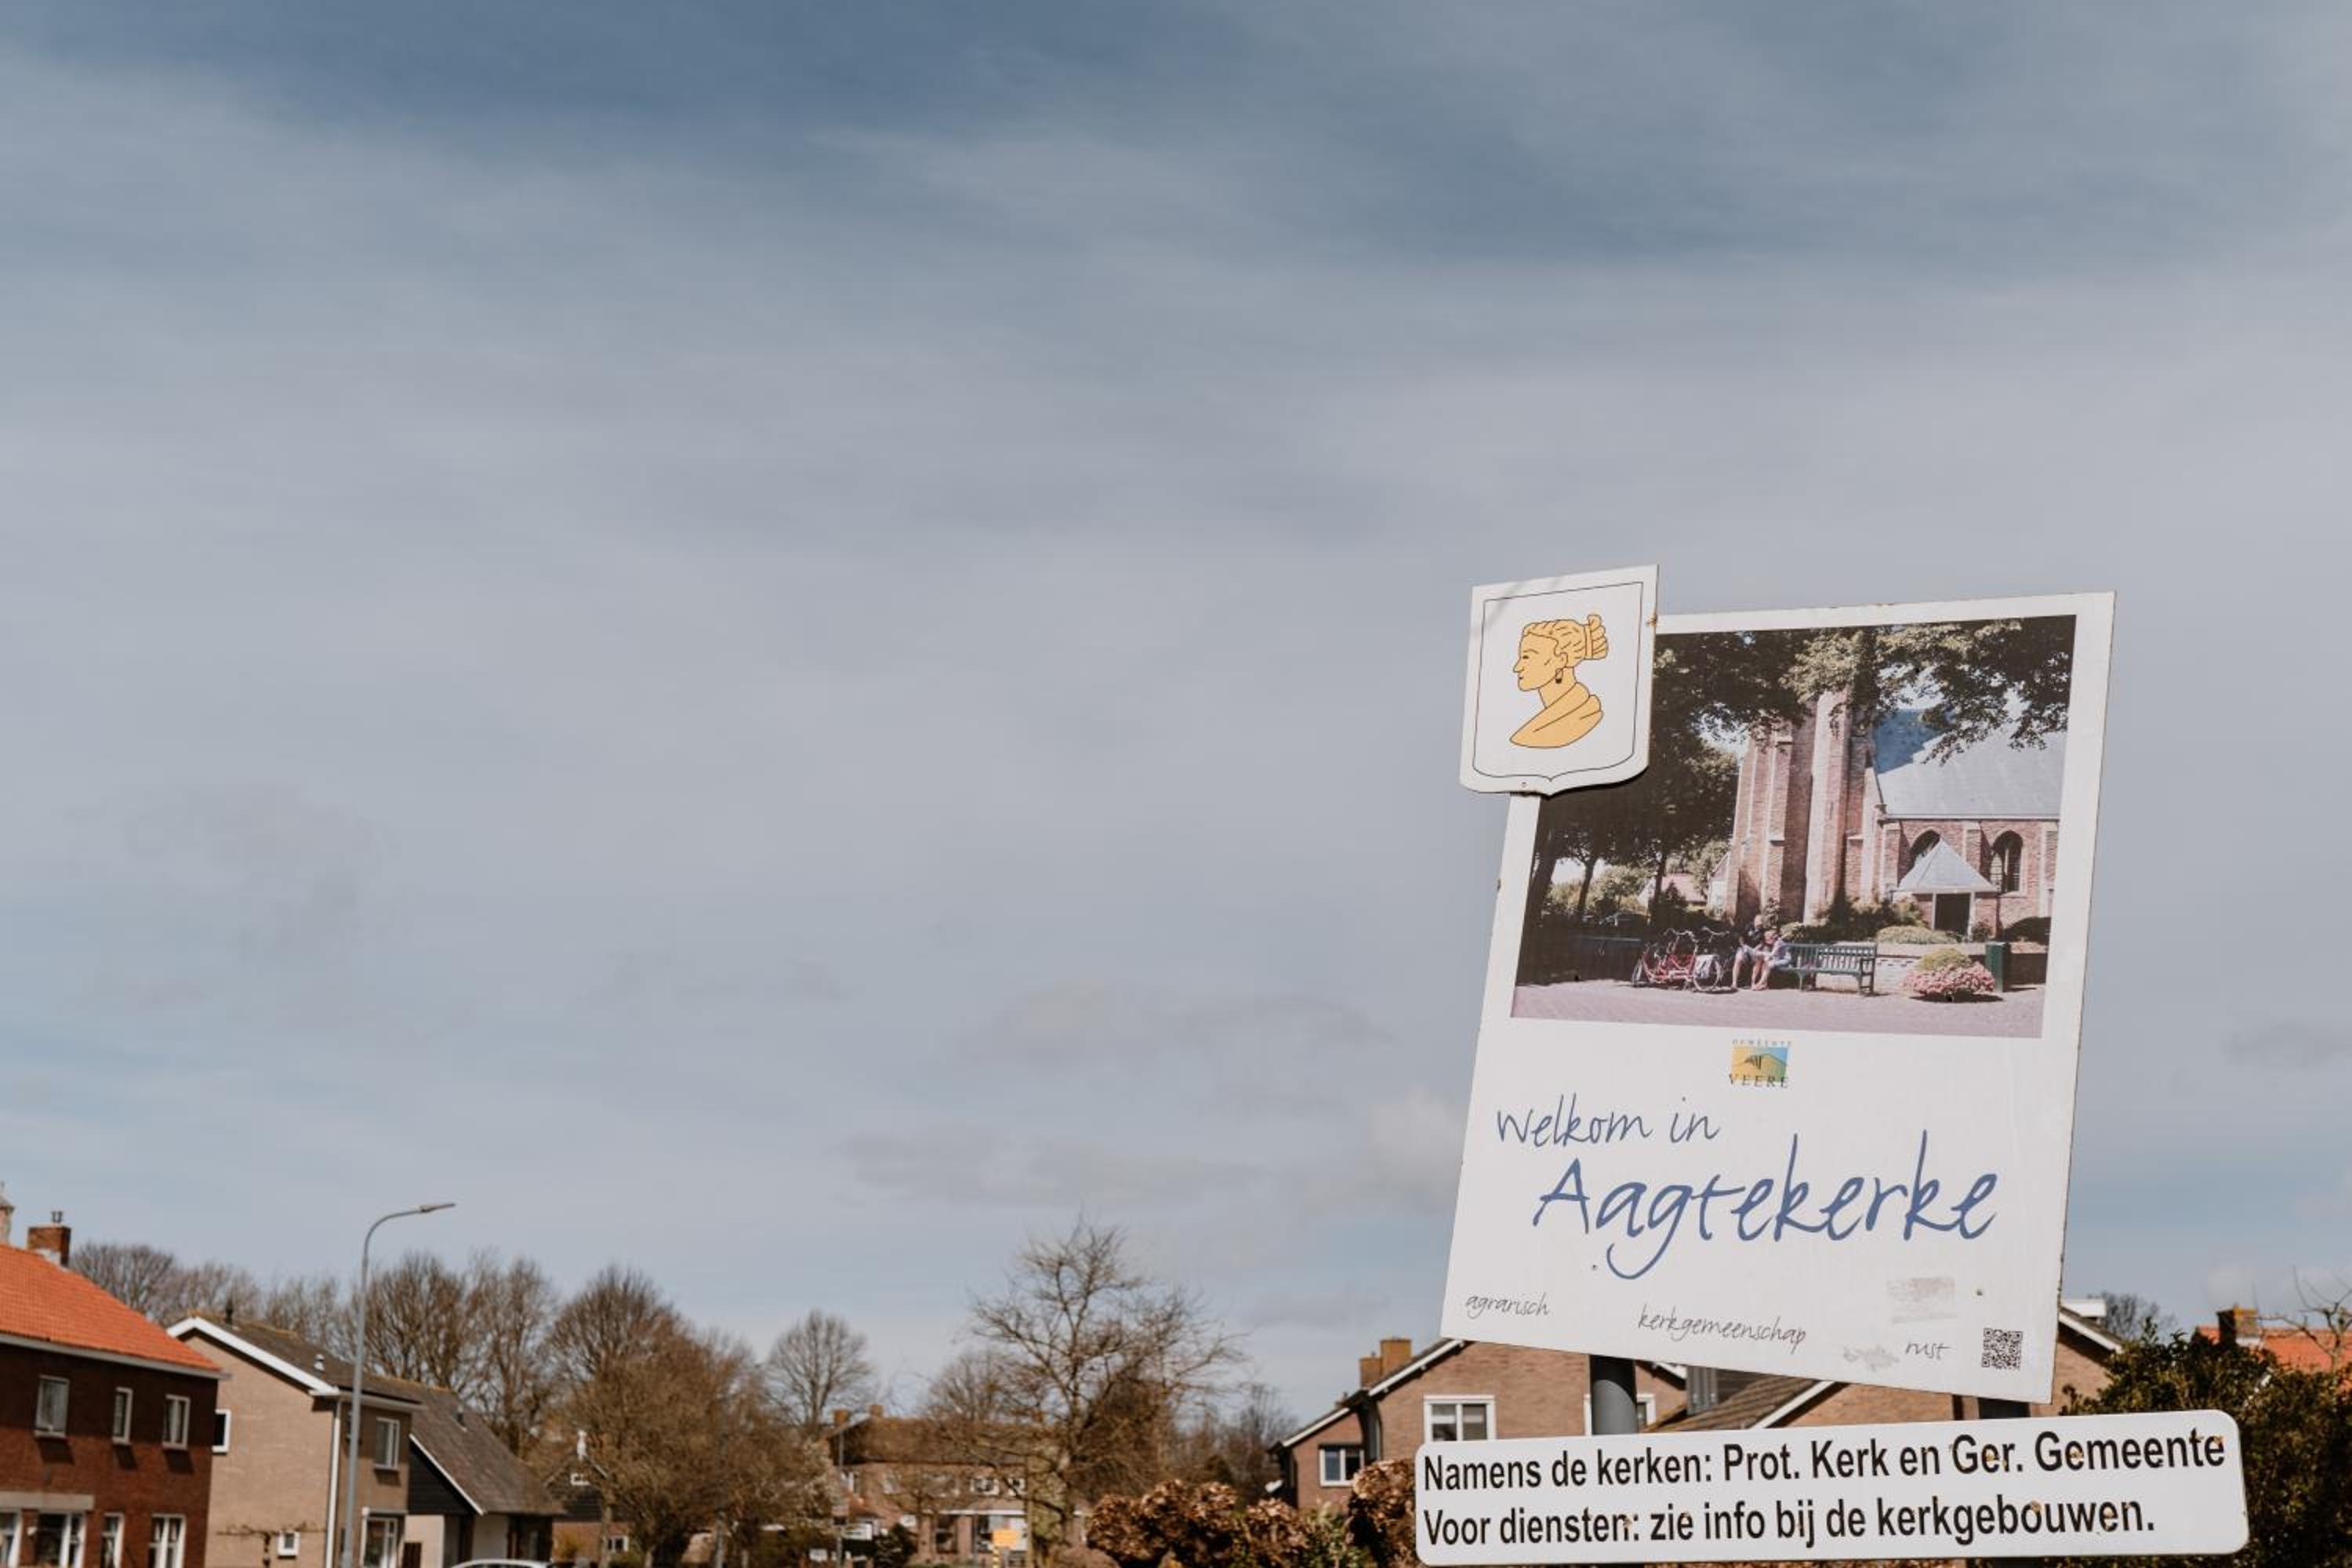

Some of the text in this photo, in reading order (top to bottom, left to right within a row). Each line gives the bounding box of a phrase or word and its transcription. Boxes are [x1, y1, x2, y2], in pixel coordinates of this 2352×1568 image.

[1729, 1073, 1788, 1088] VEERE
[1669, 1097, 1719, 1144] in
[1532, 1128, 1998, 1280] Aagtekerke
[1465, 1292, 1550, 1319] agrarisch
[1638, 1304, 1807, 1356] kerkgemeenschap
[1905, 1341, 1951, 1360] rust
[1425, 1428, 2225, 1490] Namens de kerken: Prot. Kerk en Ger. Gemeente
[1423, 1494, 2154, 1548] Voor diensten: zie info bij de kerkgebouwen.
